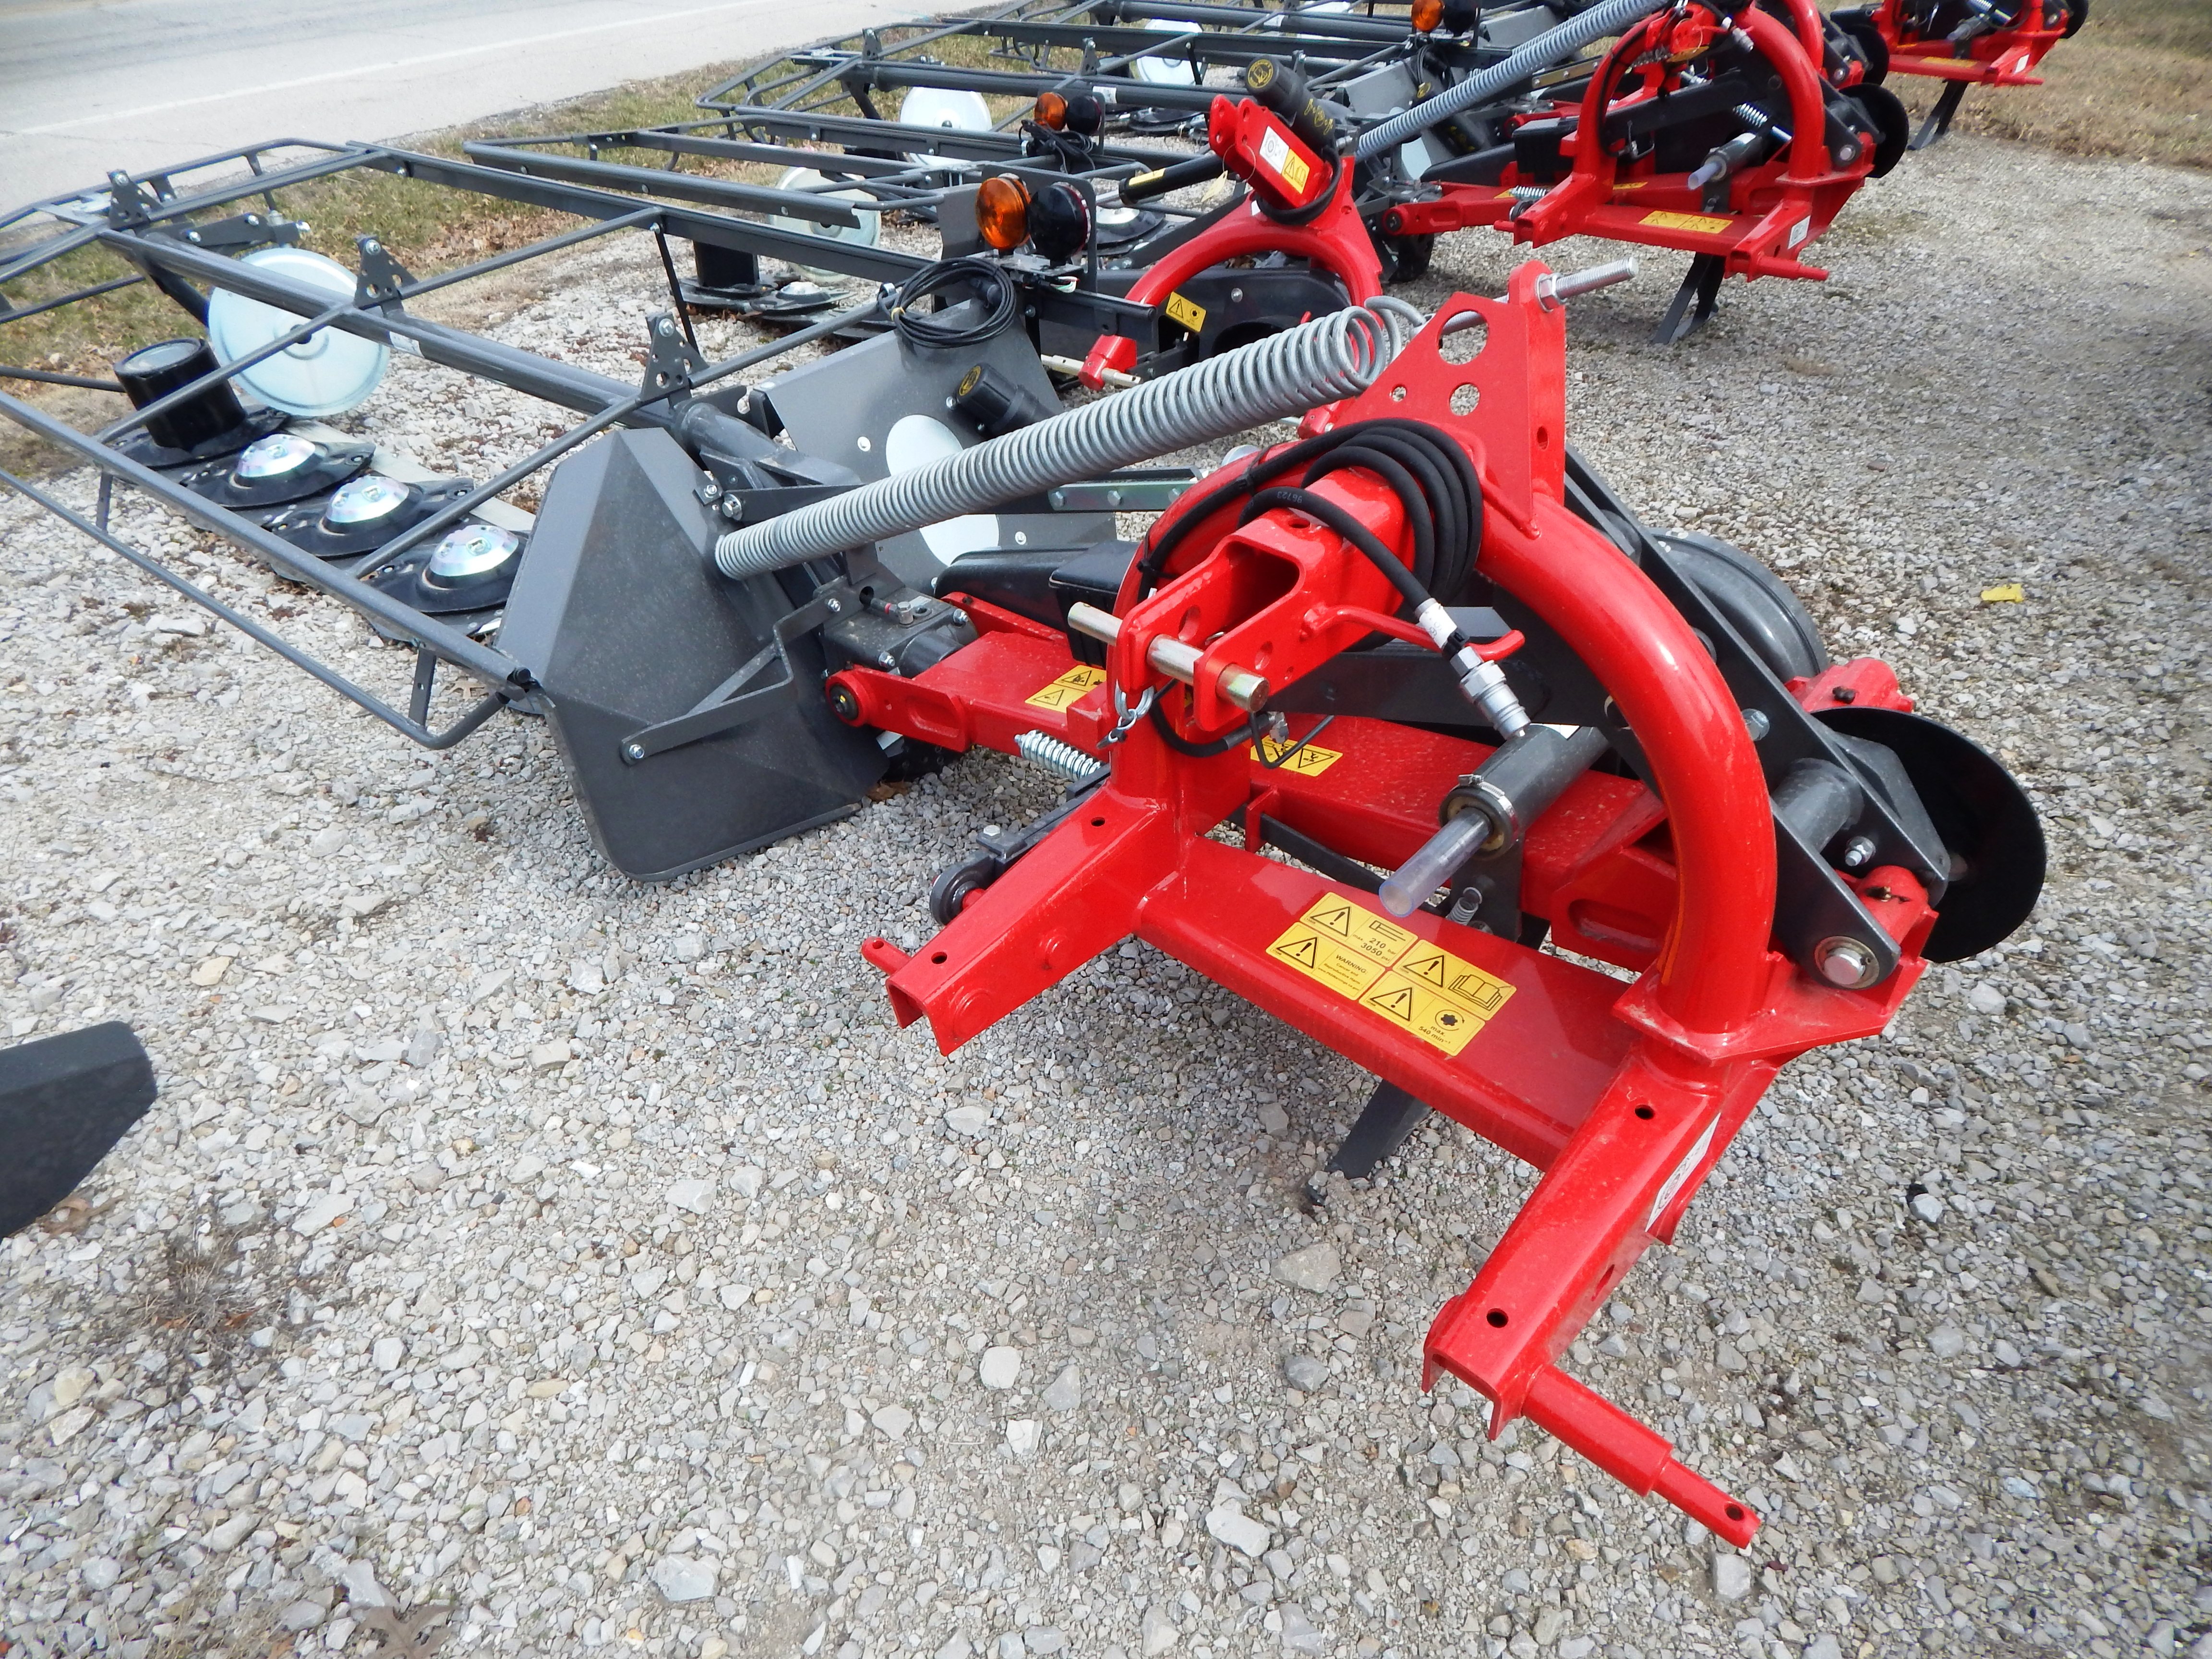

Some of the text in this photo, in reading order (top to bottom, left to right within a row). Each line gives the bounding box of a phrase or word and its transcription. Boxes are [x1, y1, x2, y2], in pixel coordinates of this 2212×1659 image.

[1277, 491, 1302, 504] 96723
[1360, 942, 1382, 956] 3050
[1369, 938, 1386, 949] 210
[1336, 963, 1351, 972] Cancer
[1419, 1026, 1431, 1035] 540
[1431, 1026, 1445, 1037] max.
